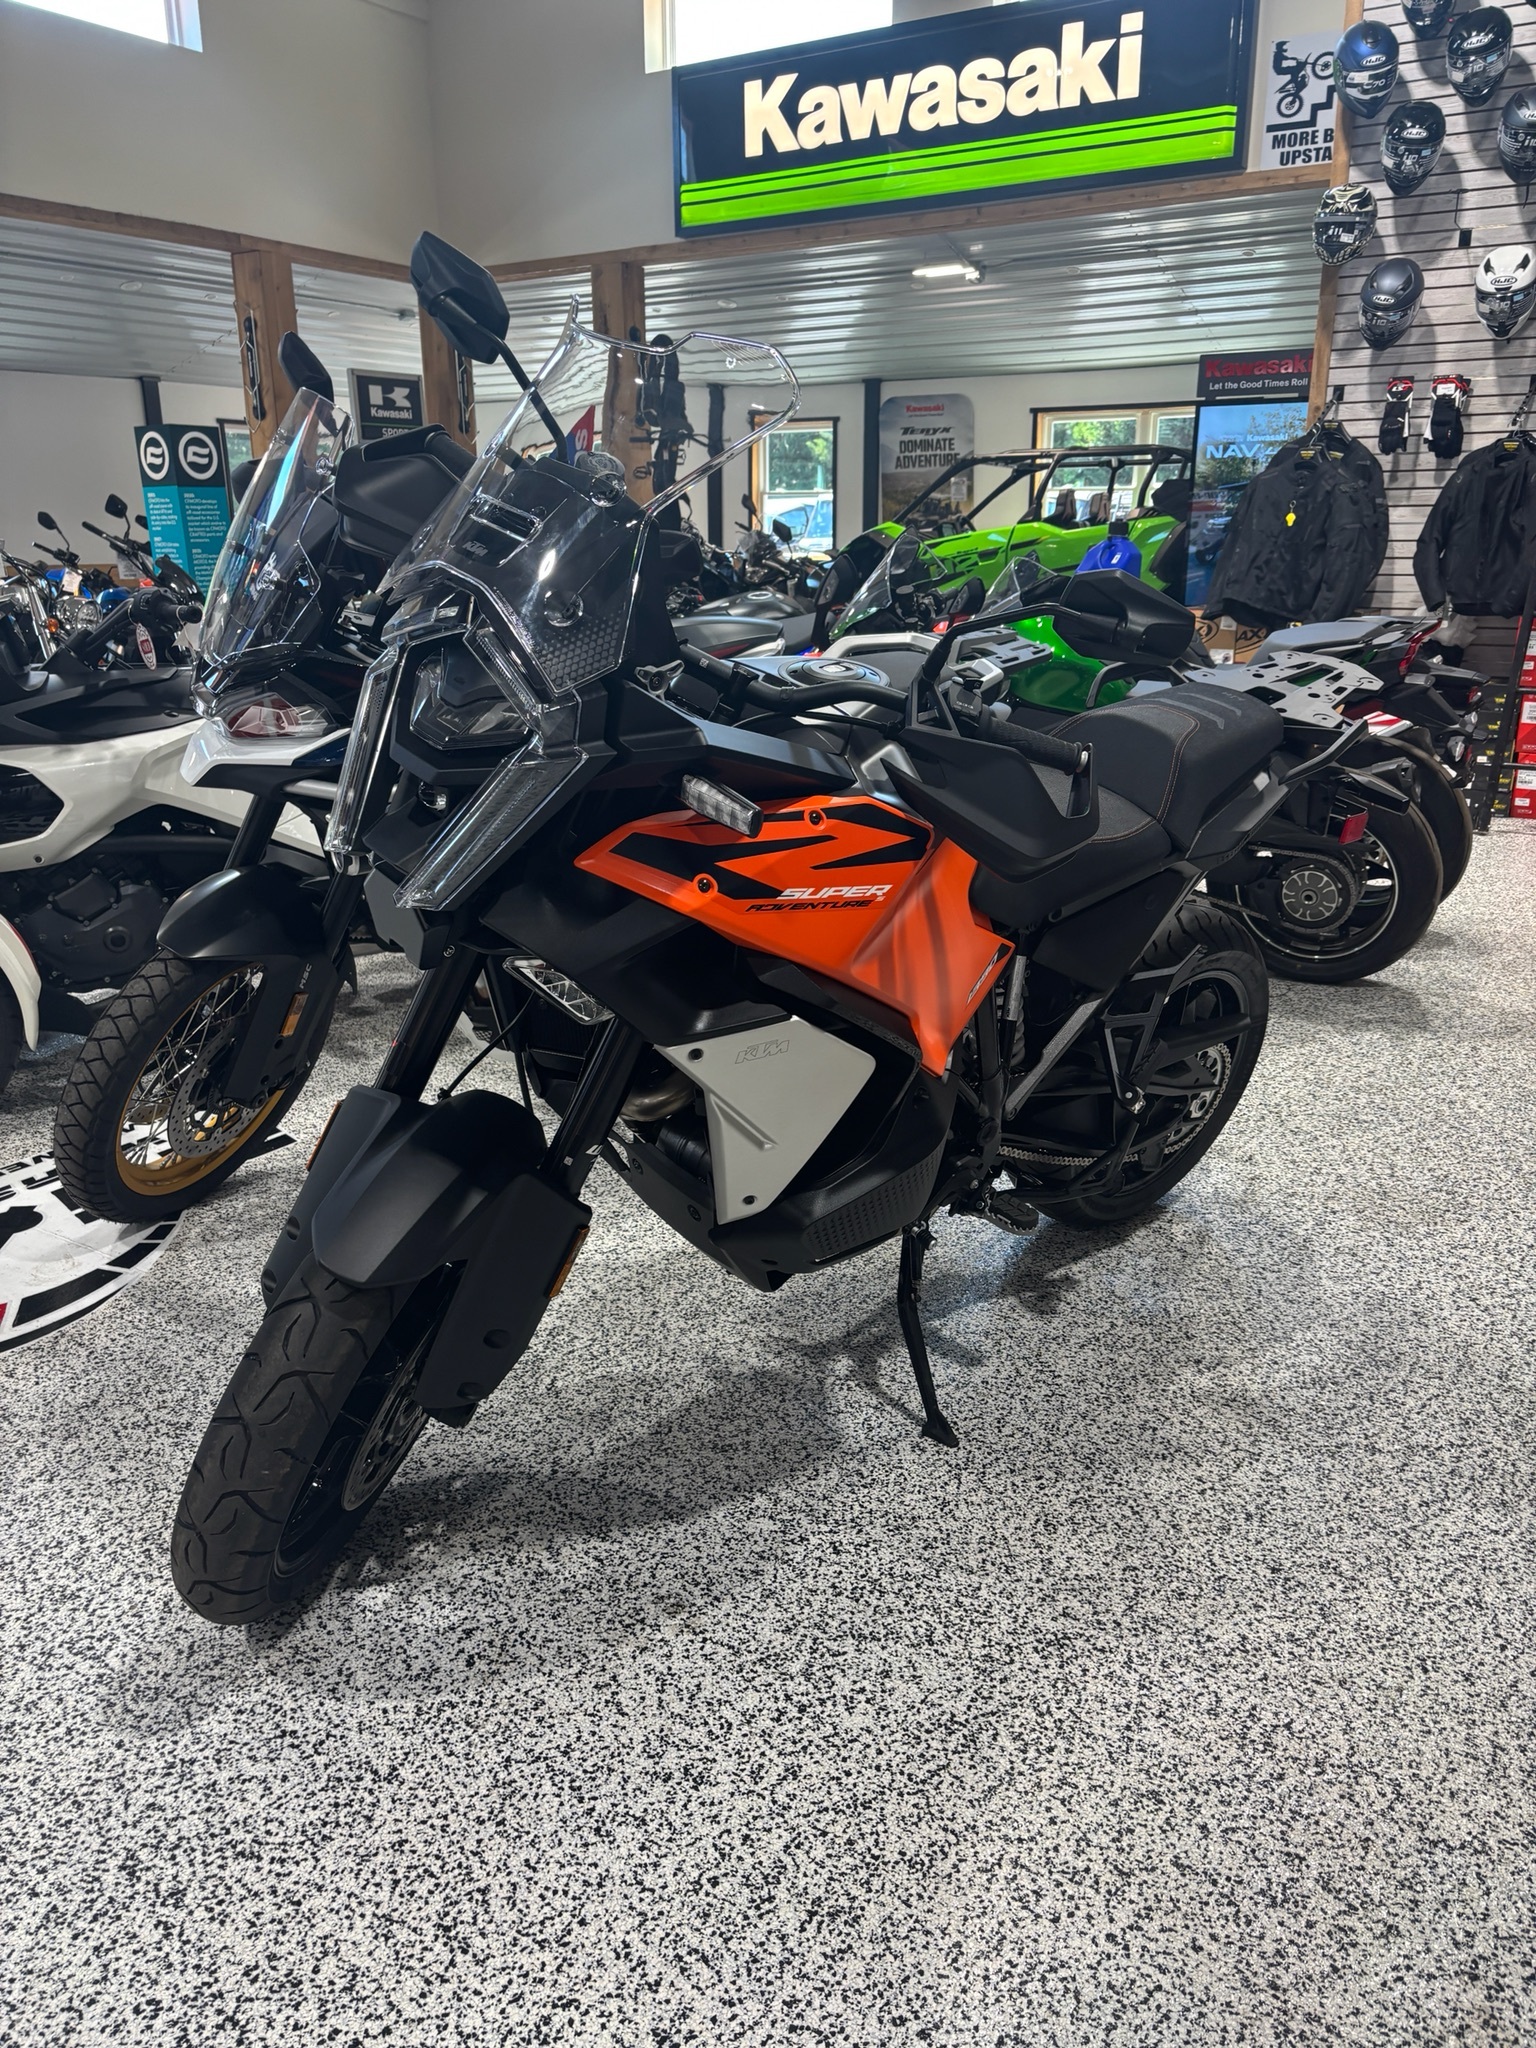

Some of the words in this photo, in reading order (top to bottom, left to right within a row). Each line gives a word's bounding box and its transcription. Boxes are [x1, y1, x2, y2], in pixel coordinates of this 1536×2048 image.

[1362, 54, 1386, 65] HJC
[744, 11, 1144, 158] Kawasaki
[1272, 130, 1319, 149] MORE
[1492, 277, 1516, 285] HJC
[1373, 295, 1395, 303] HJC
[1205, 354, 1314, 378] Kawasaki
[1209, 382, 1223, 390] Let
[1224, 381, 1238, 389] the
[1240, 380, 1262, 389] Good
[1264, 379, 1289, 388] Times
[1291, 377, 1308, 386] Roll
[371, 407, 413, 419] Kawasaki
[905, 403, 945, 413] Kawasaki
[1246, 433, 1288, 441] Kawasaki
[899, 437, 955, 454] DOMINATE
[462, 541, 488, 557] KTM
[776, 884, 893, 900] SUPER
[745, 899, 875, 913] ADVENTURE
[299, 963, 312, 989] MSC
[735, 1039, 790, 1064] KTM
